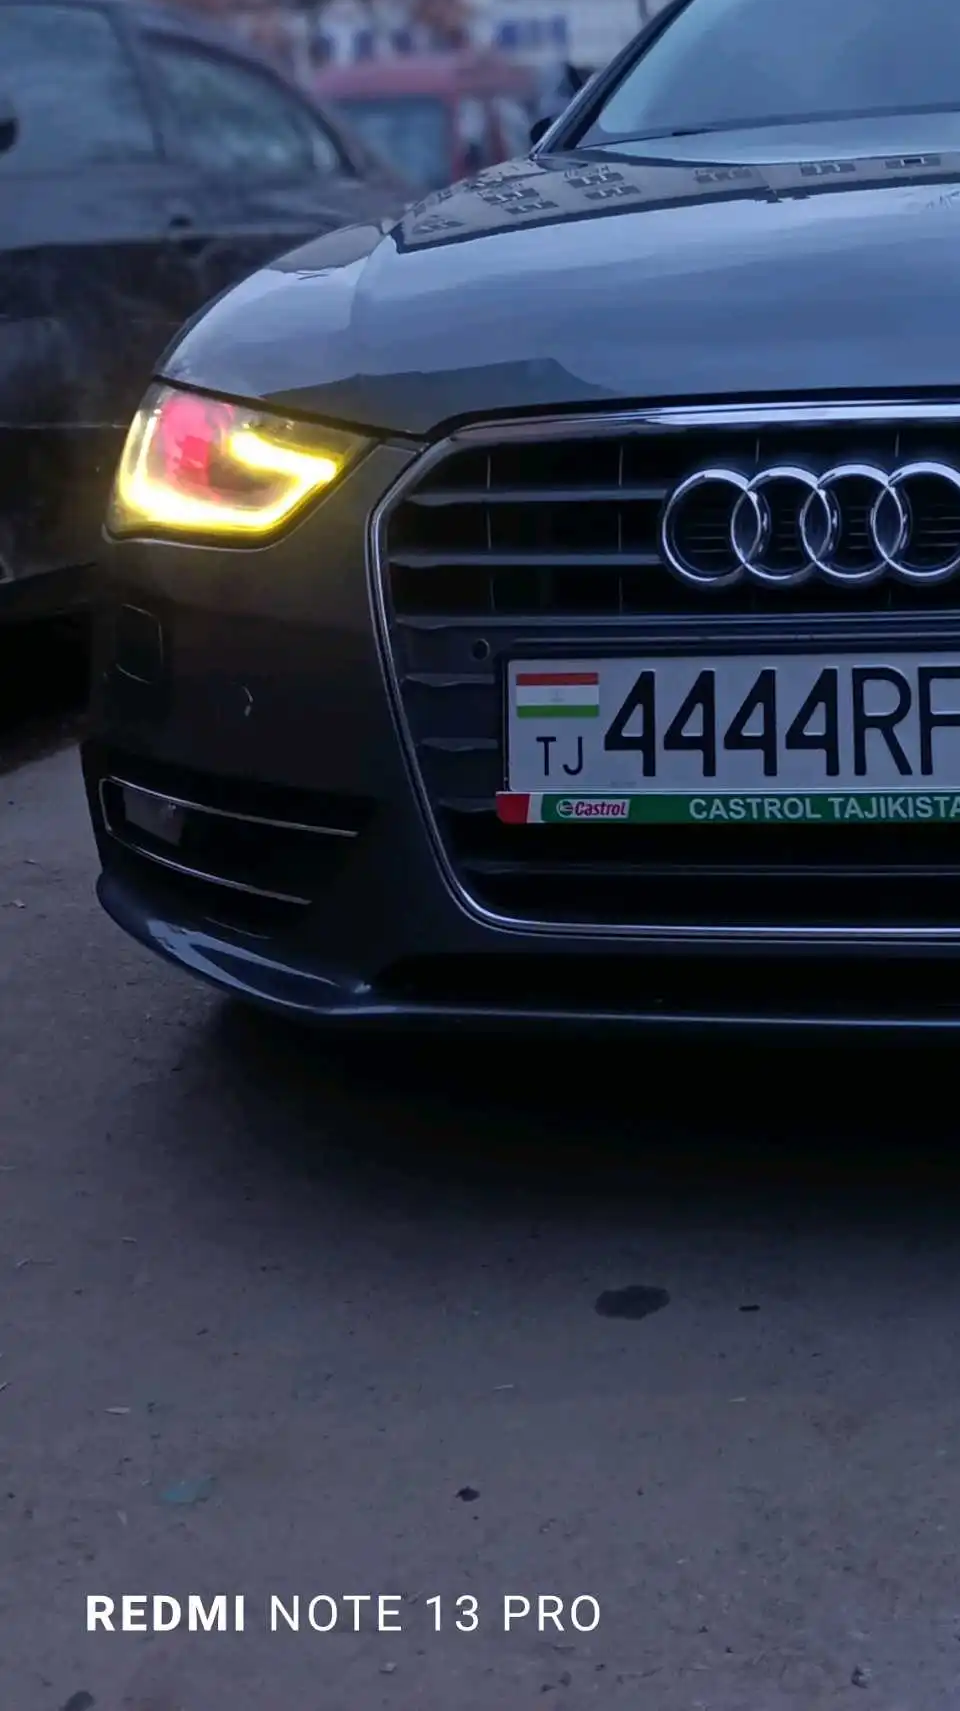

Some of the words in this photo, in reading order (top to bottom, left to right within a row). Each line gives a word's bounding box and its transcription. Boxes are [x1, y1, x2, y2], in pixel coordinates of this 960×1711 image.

[535, 735, 583, 776] TJ
[574, 800, 626, 816] Castrol
[689, 798, 821, 819] CASTROL
